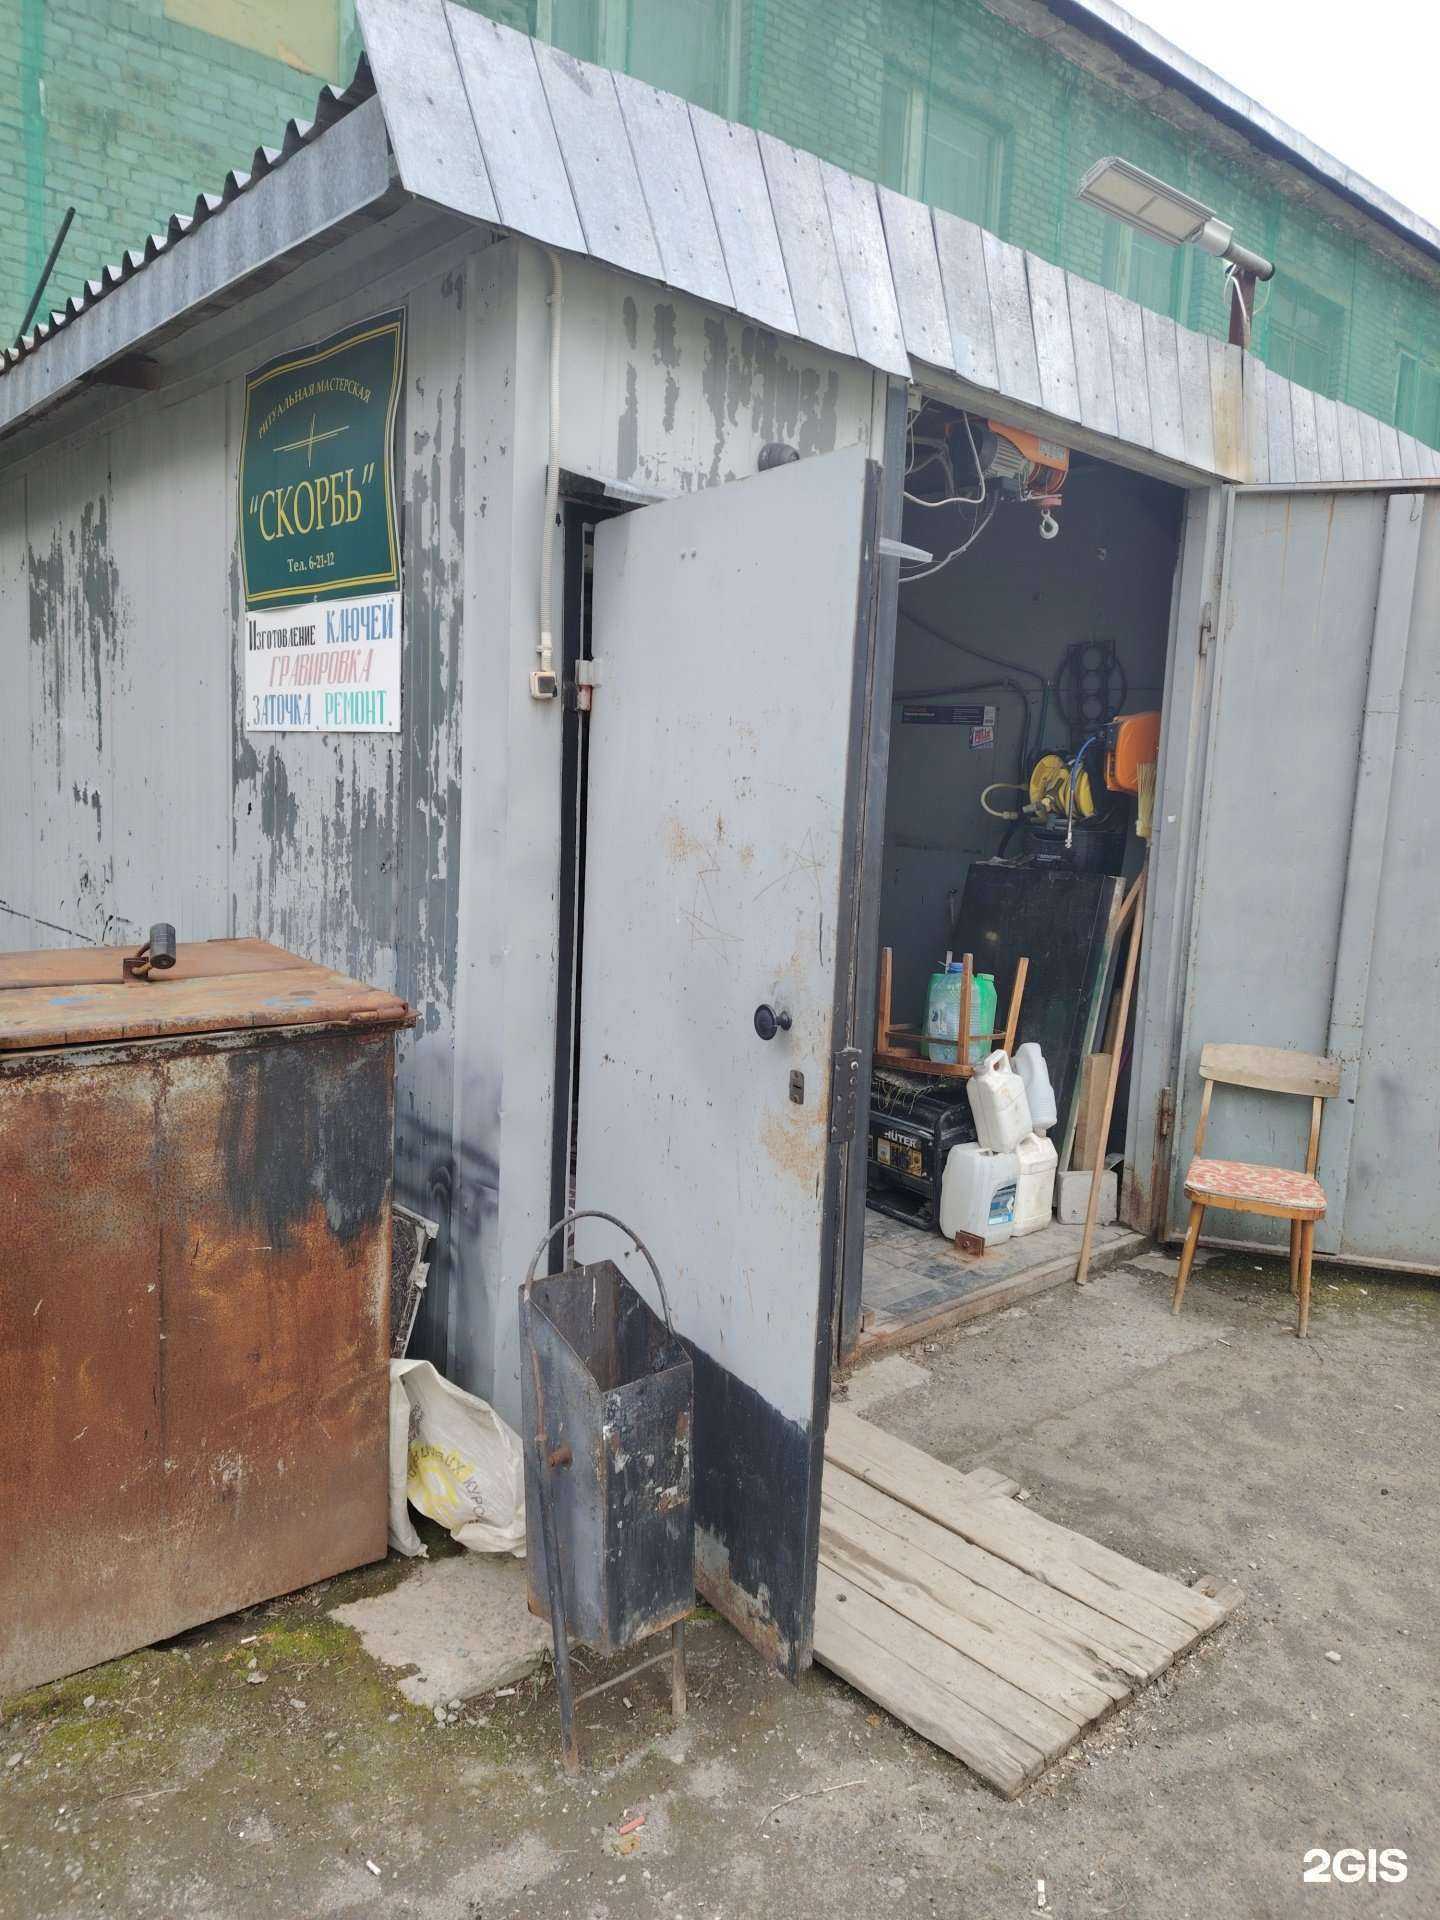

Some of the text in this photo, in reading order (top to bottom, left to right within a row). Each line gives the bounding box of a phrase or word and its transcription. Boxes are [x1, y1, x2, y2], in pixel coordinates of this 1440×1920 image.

[258, 377, 372, 440] РИТУАЛЬНАЯ МАСТЕРСКАЯ
[287, 551, 335, 574] Тел. 6-21-12
[326, 599, 395, 644] КЛЮЧЕЙ
[269, 649, 374, 688] ГРАВИРОВКА
[252, 690, 386, 725] ЗАТОЧКА РЕМОНТ
